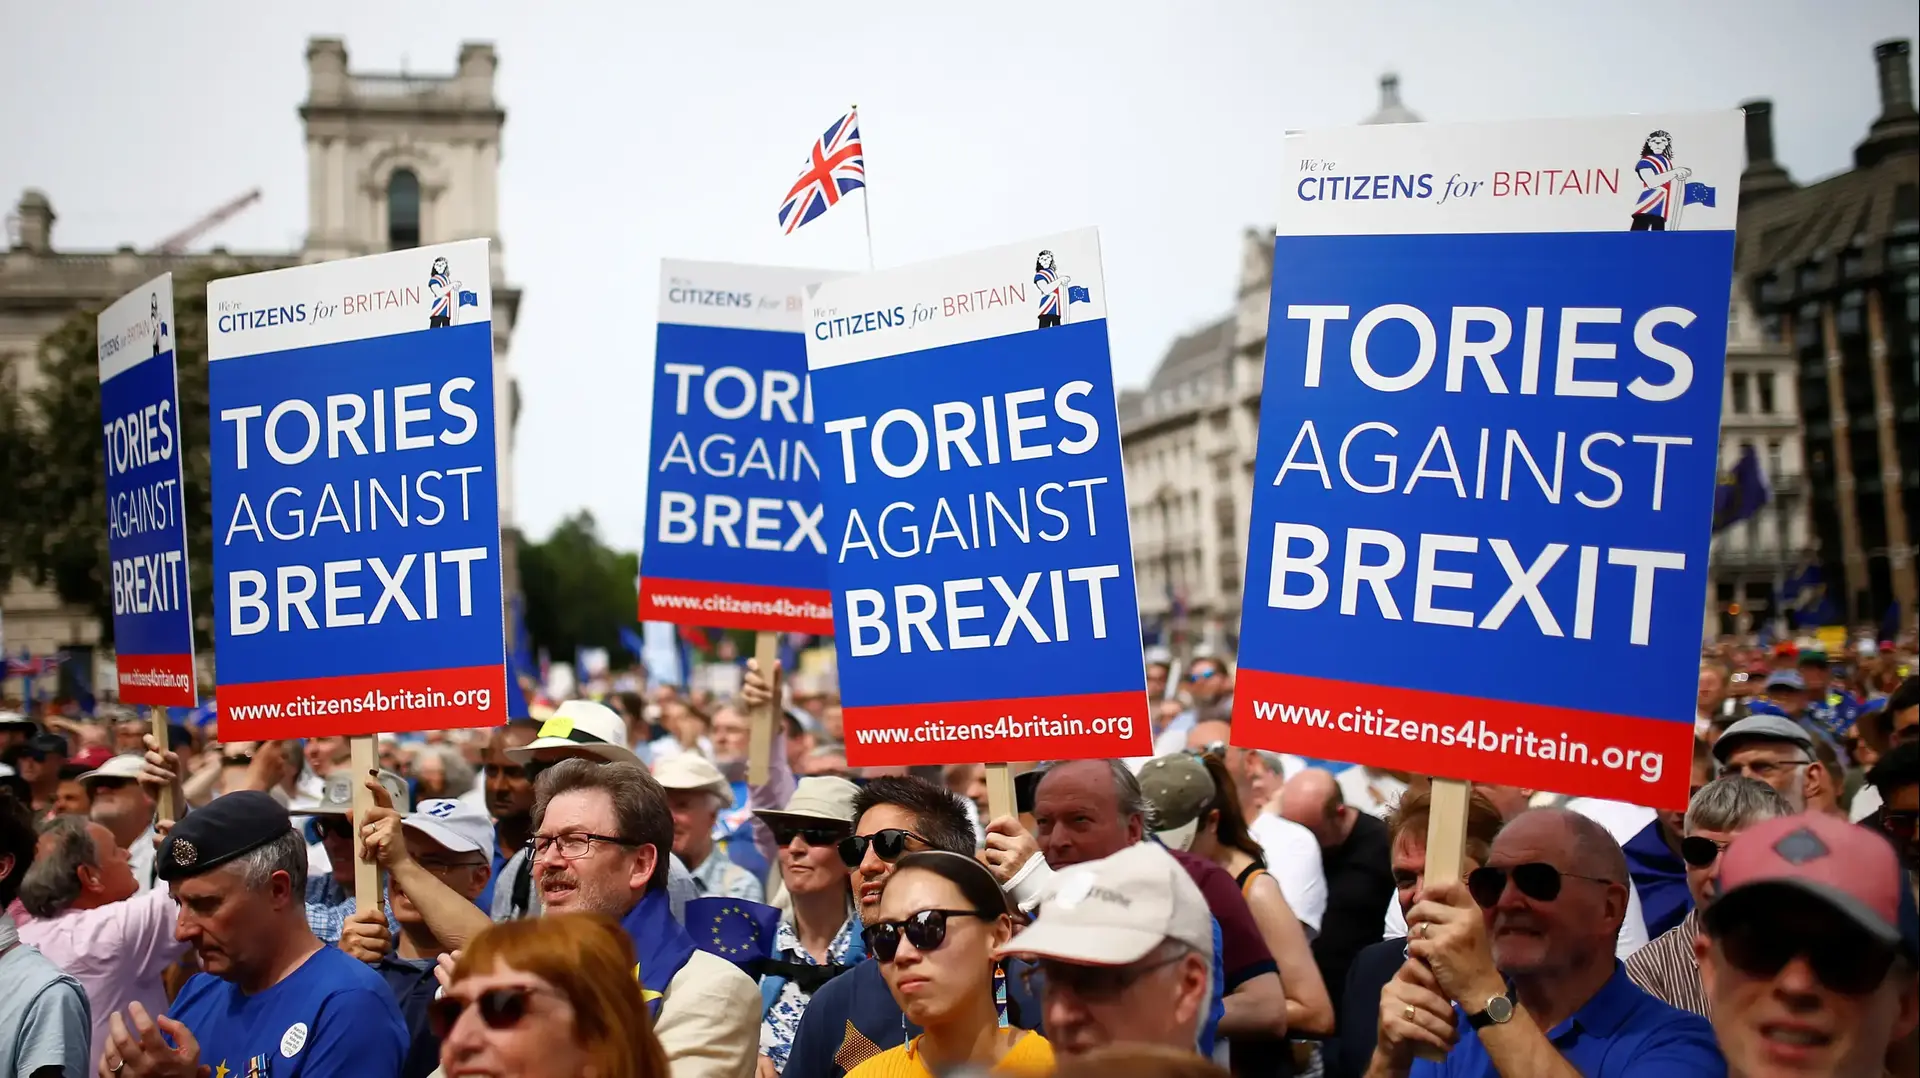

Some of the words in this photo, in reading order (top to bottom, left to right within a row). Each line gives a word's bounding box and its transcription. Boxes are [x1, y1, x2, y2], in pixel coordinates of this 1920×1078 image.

[1297, 173, 1434, 201] CITIZENS
[1437, 173, 1483, 205] for
[1493, 167, 1619, 197] BRITAIN
[1299, 158, 1336, 172] We're
[218, 300, 242, 312] We're
[218, 303, 306, 333] CITIZENS
[309, 301, 338, 325] for
[343, 286, 420, 315] BRITAIN
[669, 287, 752, 309] CITIZENS
[815, 306, 905, 341] CITIZENS
[909, 303, 938, 329] for
[943, 283, 1025, 317] BRITAIN
[1288, 304, 1697, 401] TORIES
[104, 399, 174, 476] TORIES
[221, 377, 477, 469] TORIES
[825, 381, 1099, 483] TORIES
[1273, 420, 1692, 510] AGAINST
[110, 479, 176, 540] AGAINST
[225, 466, 482, 545] AGAINST
[659, 491, 827, 554] BREX
[839, 477, 1107, 563] AGAINST
[113, 551, 182, 615] BREXIT
[230, 547, 487, 635] BREXIT
[846, 565, 1119, 656] BREXIT
[1268, 522, 1685, 645] BREXIT
[230, 687, 490, 720] www.citizens4britain.org
[856, 714, 1132, 744] www.citizens4britain.org
[1253, 701, 1662, 782] www.citizens4britain.org
